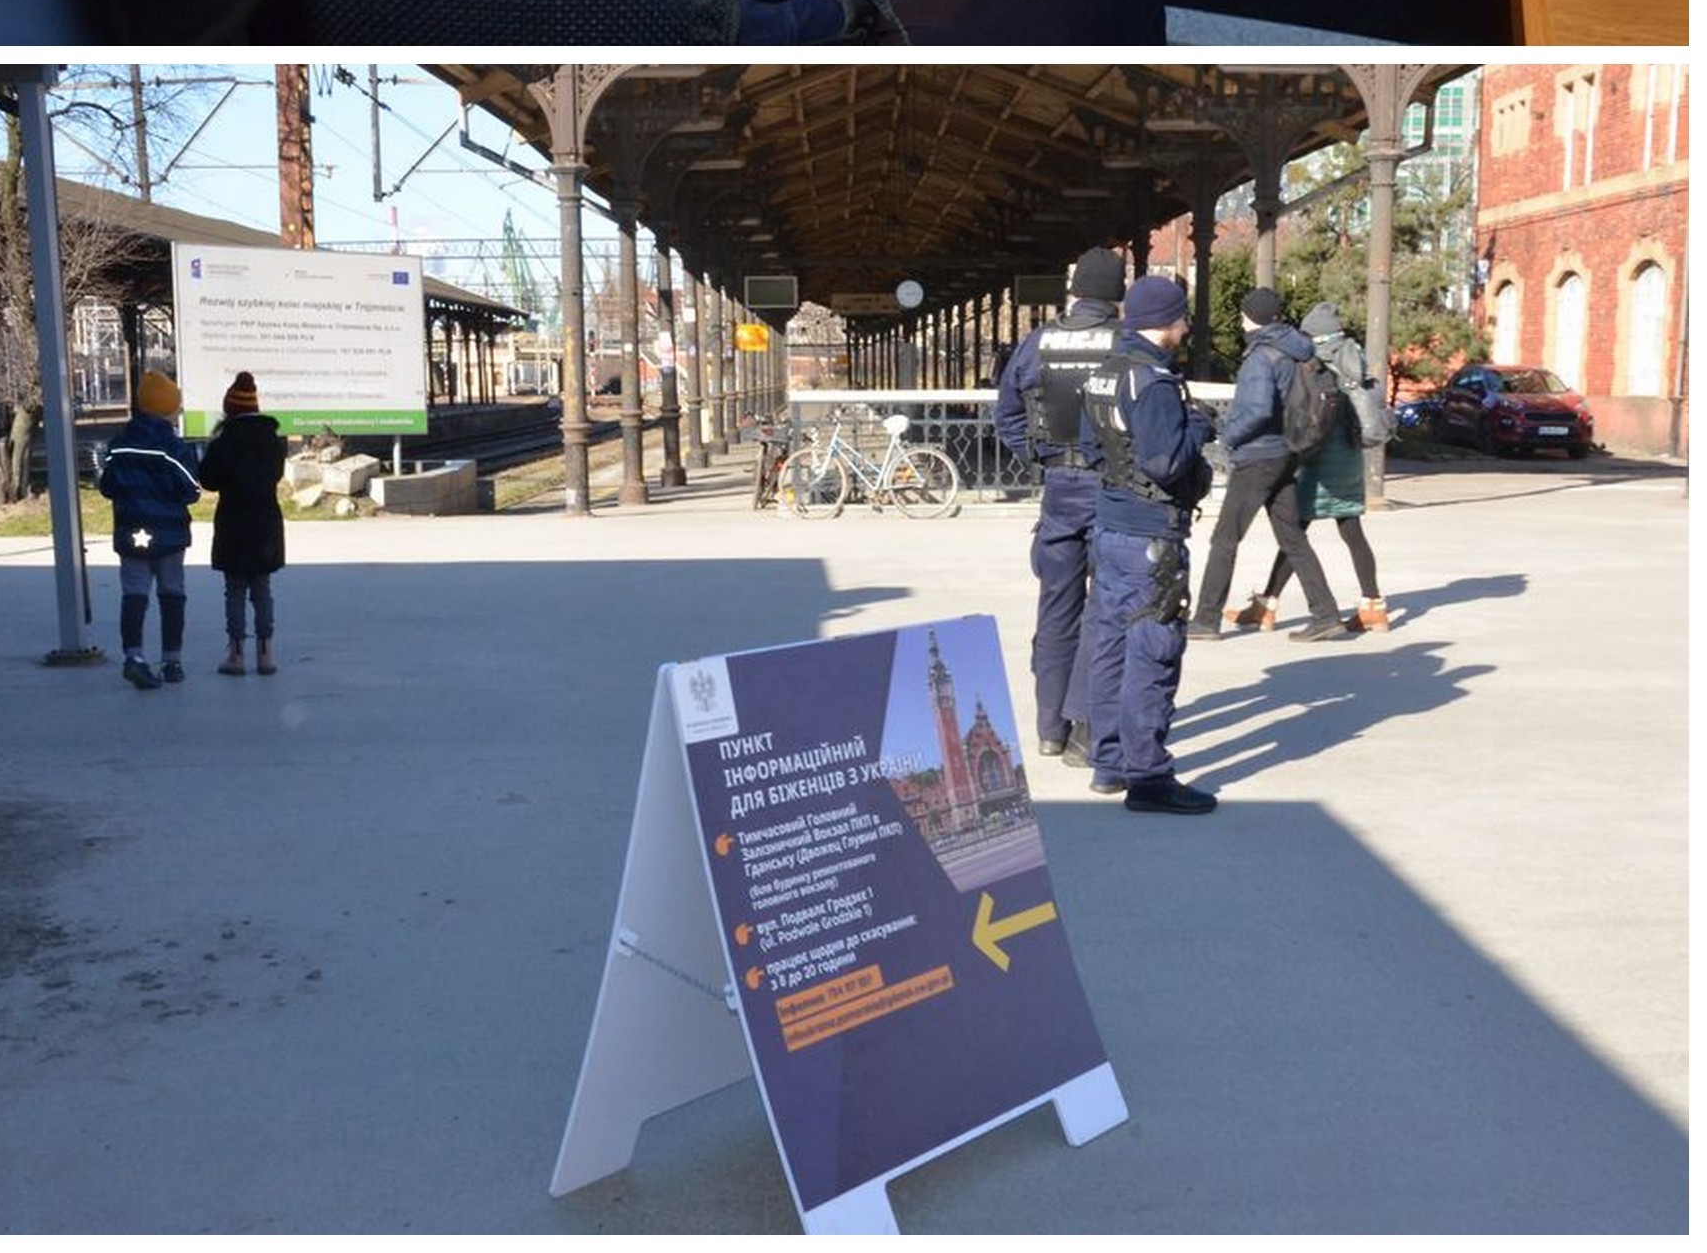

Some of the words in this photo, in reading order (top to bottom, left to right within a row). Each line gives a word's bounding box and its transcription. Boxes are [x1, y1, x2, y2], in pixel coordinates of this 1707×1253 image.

[719, 732, 774, 761] ПУНКТ
[723, 735, 867, 789] ІНФОРМАЦІЙНИЙ
[730, 791, 765, 820] ДЛЯ
[769, 771, 846, 806] БІЖЕНЦІВ
[849, 767, 861, 787] З
[737, 817, 807, 846] Тимчасовий
[806, 802, 858, 829] Головний
[813, 821, 851, 843] Вокзал
[744, 852, 795, 879] Гданську
[778, 923, 821, 947] Podwale
[820, 907, 864, 930] Grodzkie
[846, 933, 861, 951] до
[779, 974, 787, 988] 8
[787, 969, 804, 989] до
[803, 964, 817, 980] 20
